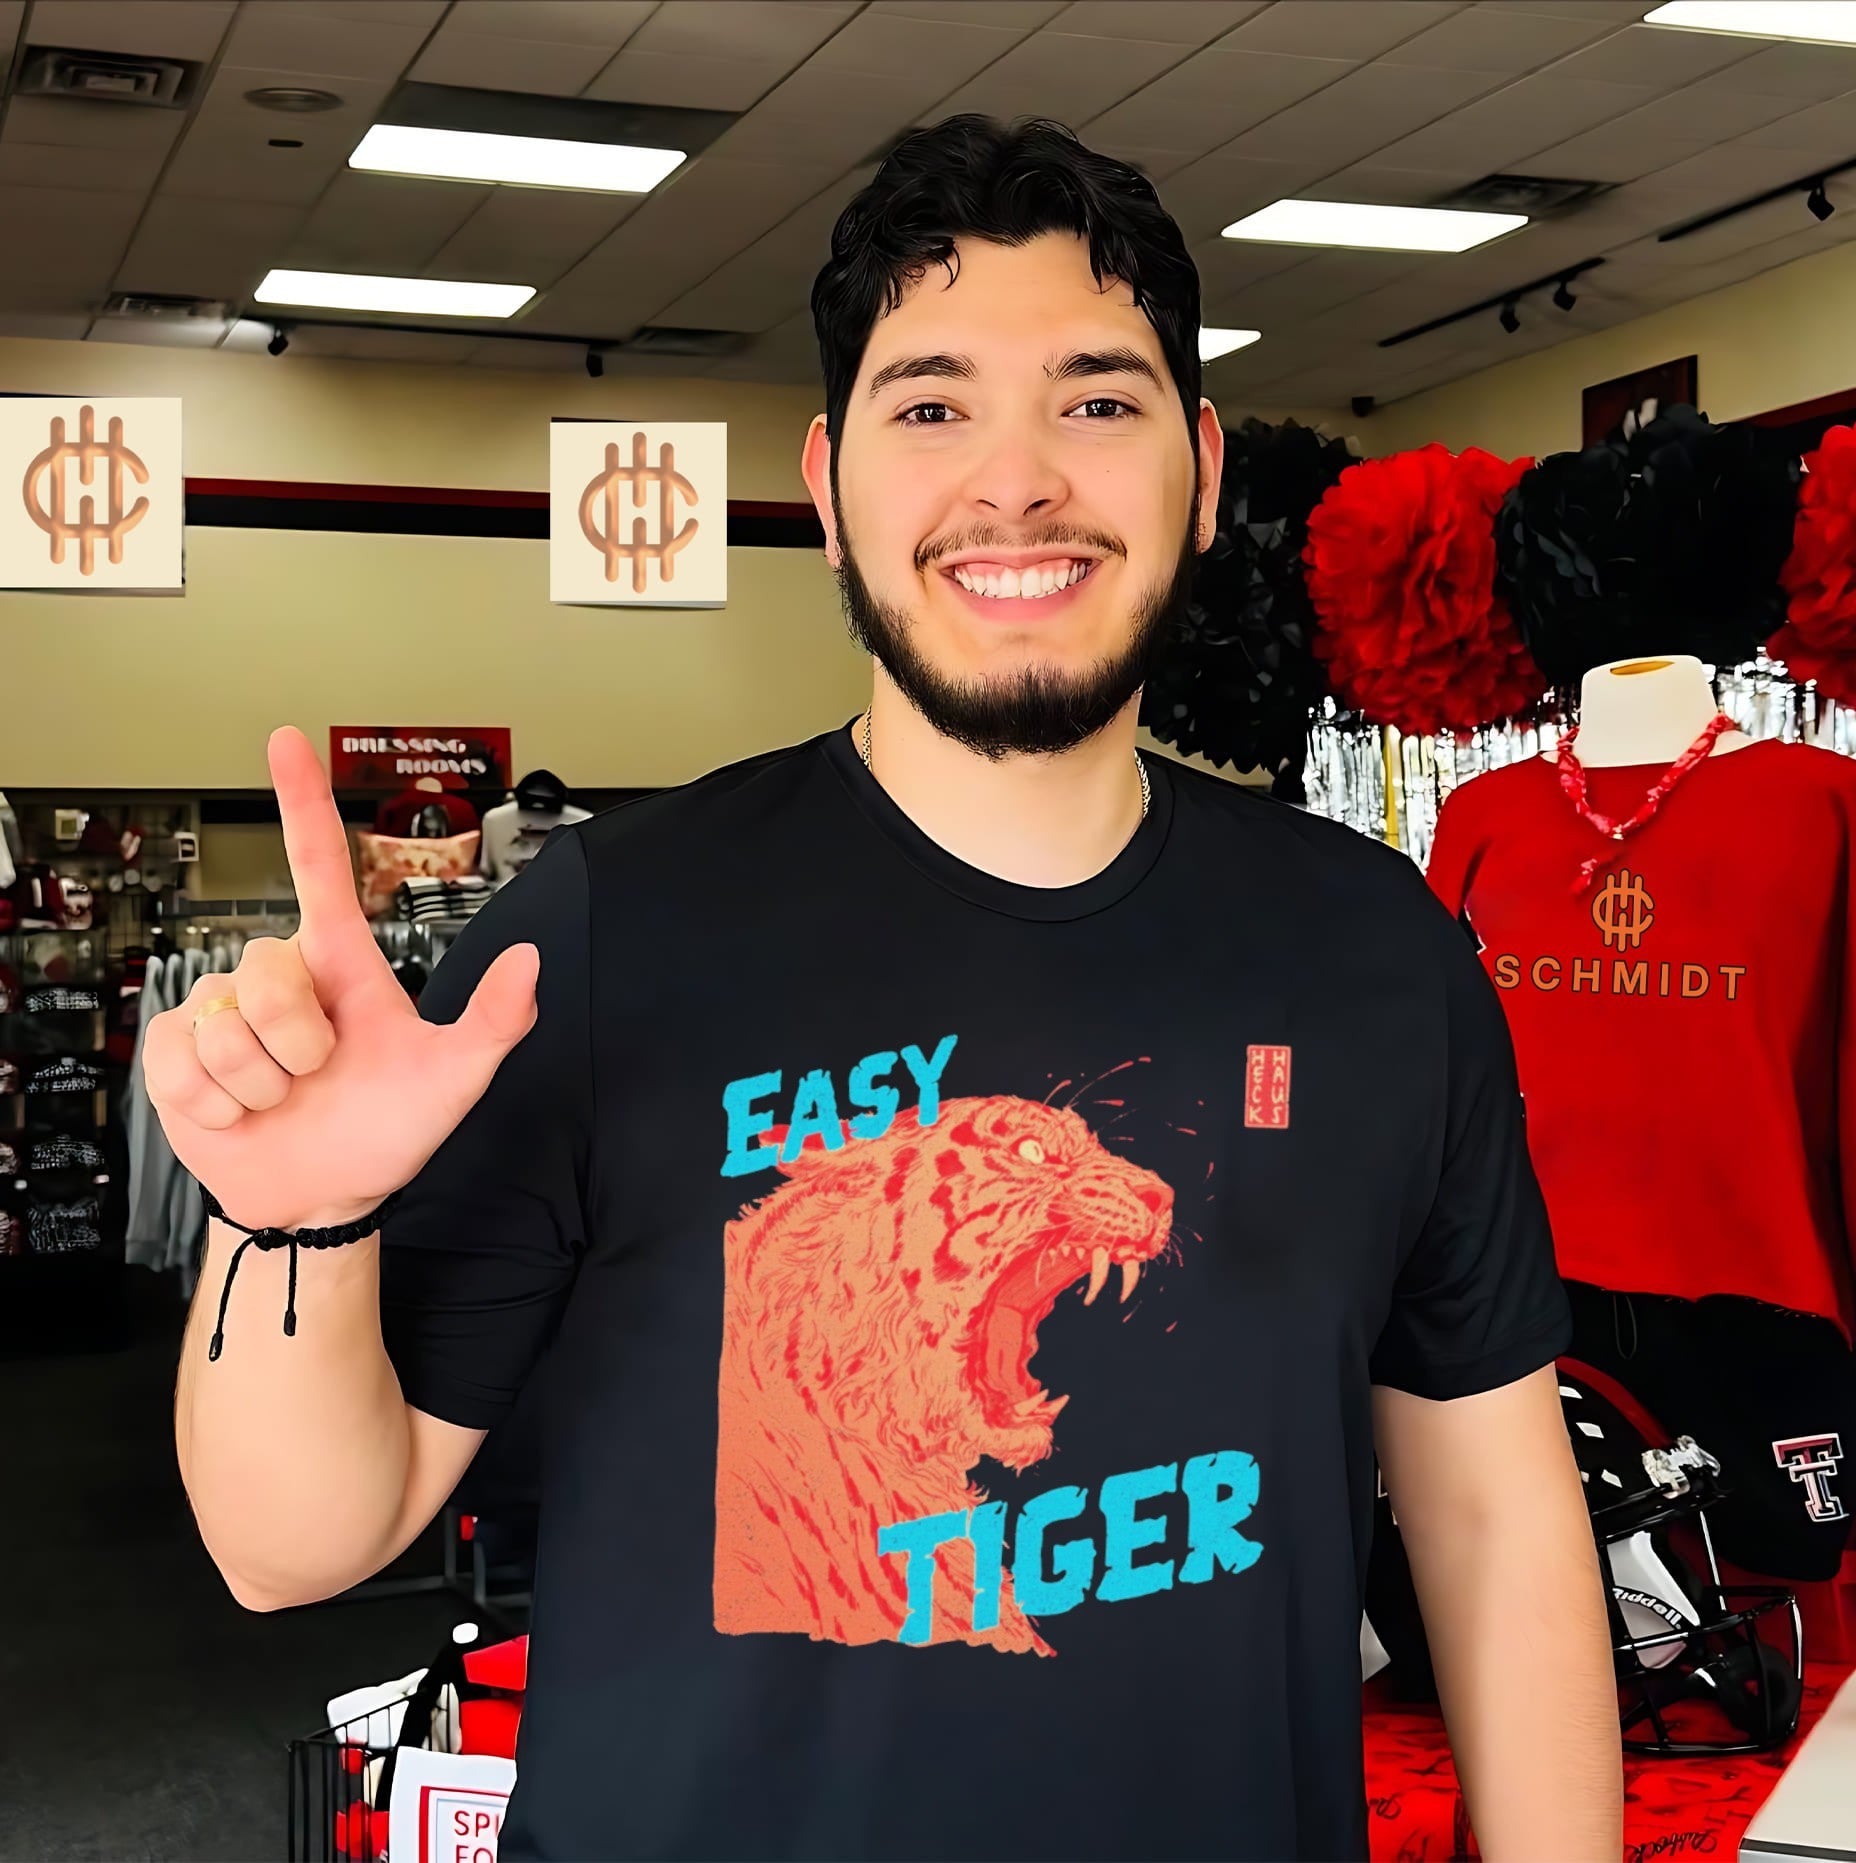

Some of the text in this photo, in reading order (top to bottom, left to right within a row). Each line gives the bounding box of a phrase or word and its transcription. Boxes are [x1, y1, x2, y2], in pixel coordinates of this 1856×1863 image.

[396, 759, 487, 774] ROOMS
[1494, 953, 1747, 1000] SCHMIDT
[720, 1034, 958, 1178] EASY
[1249, 1049, 1266, 1124] HECK
[1271, 1049, 1286, 1124] HAUS
[878, 1450, 1265, 1645] TIGER
